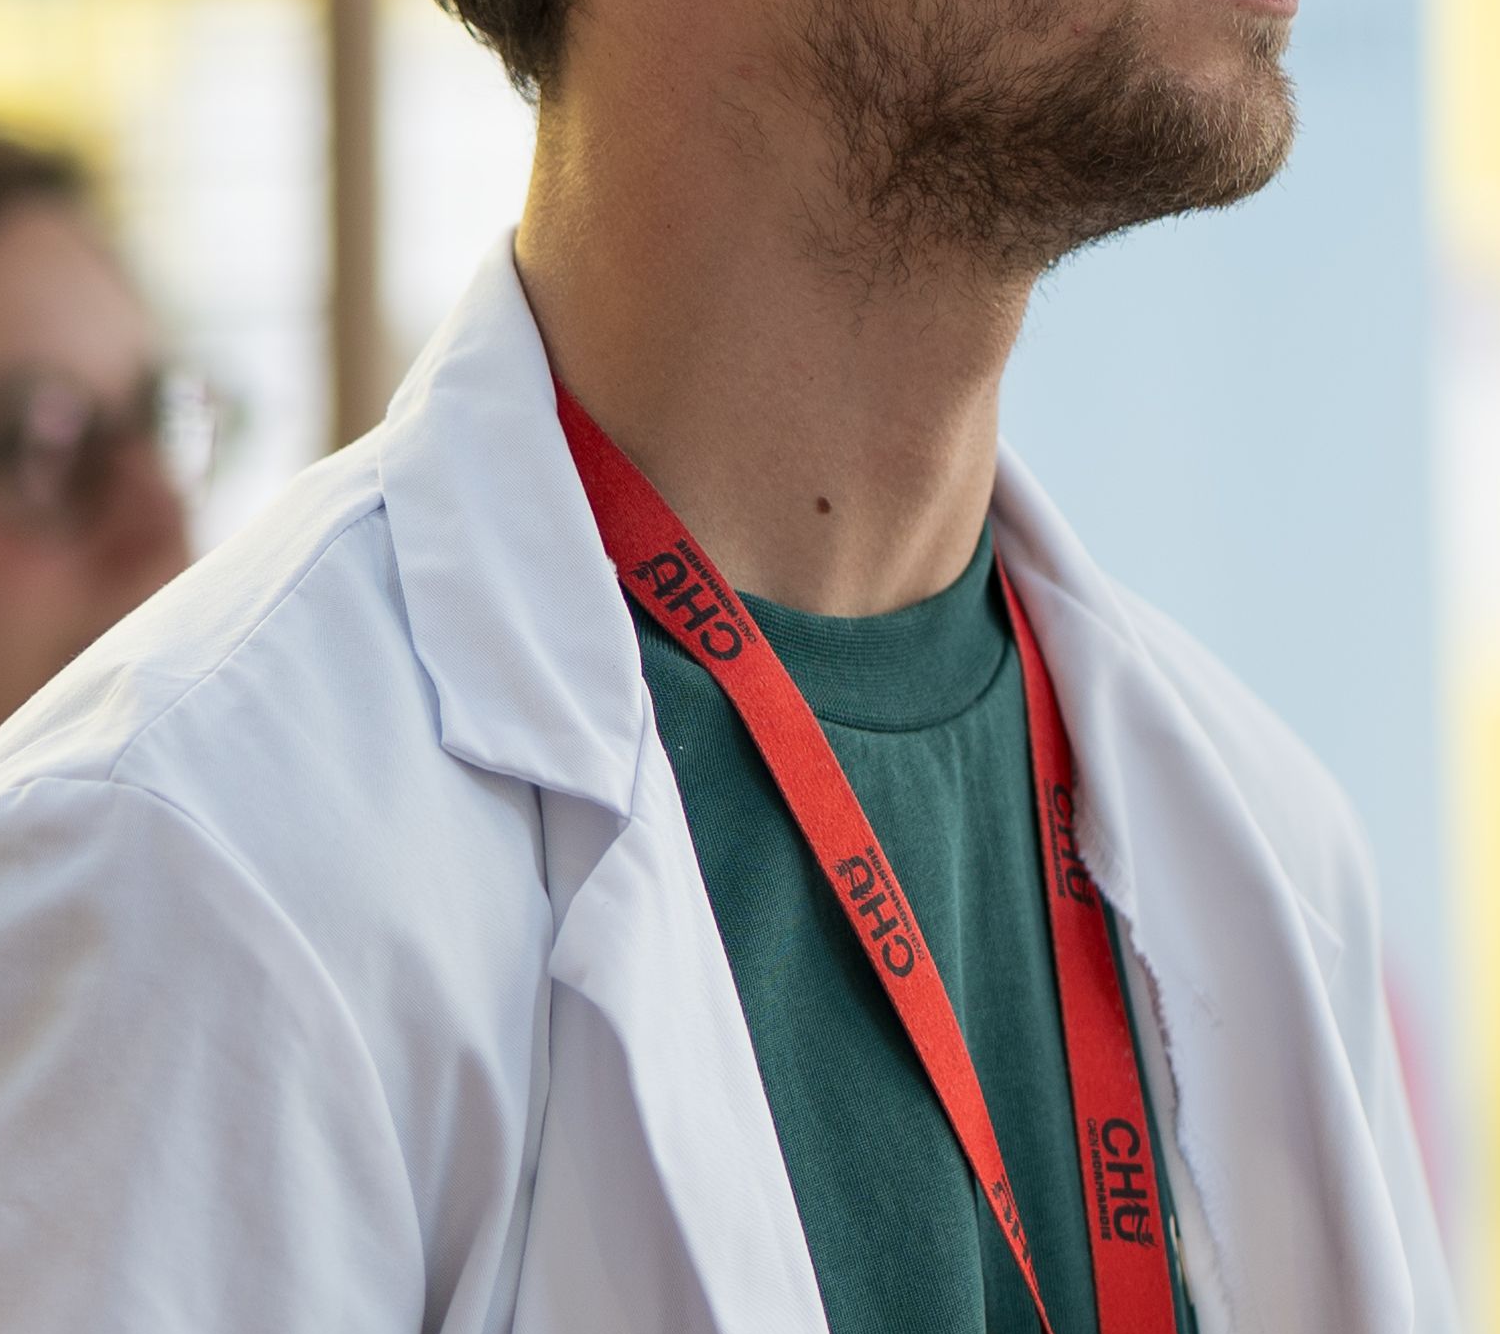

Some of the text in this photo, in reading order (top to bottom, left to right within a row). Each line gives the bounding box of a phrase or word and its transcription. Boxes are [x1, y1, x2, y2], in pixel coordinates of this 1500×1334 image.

[646, 551, 743, 661] CHU
[848, 855, 915, 978] CHU
[1101, 1118, 1152, 1246] CHU
